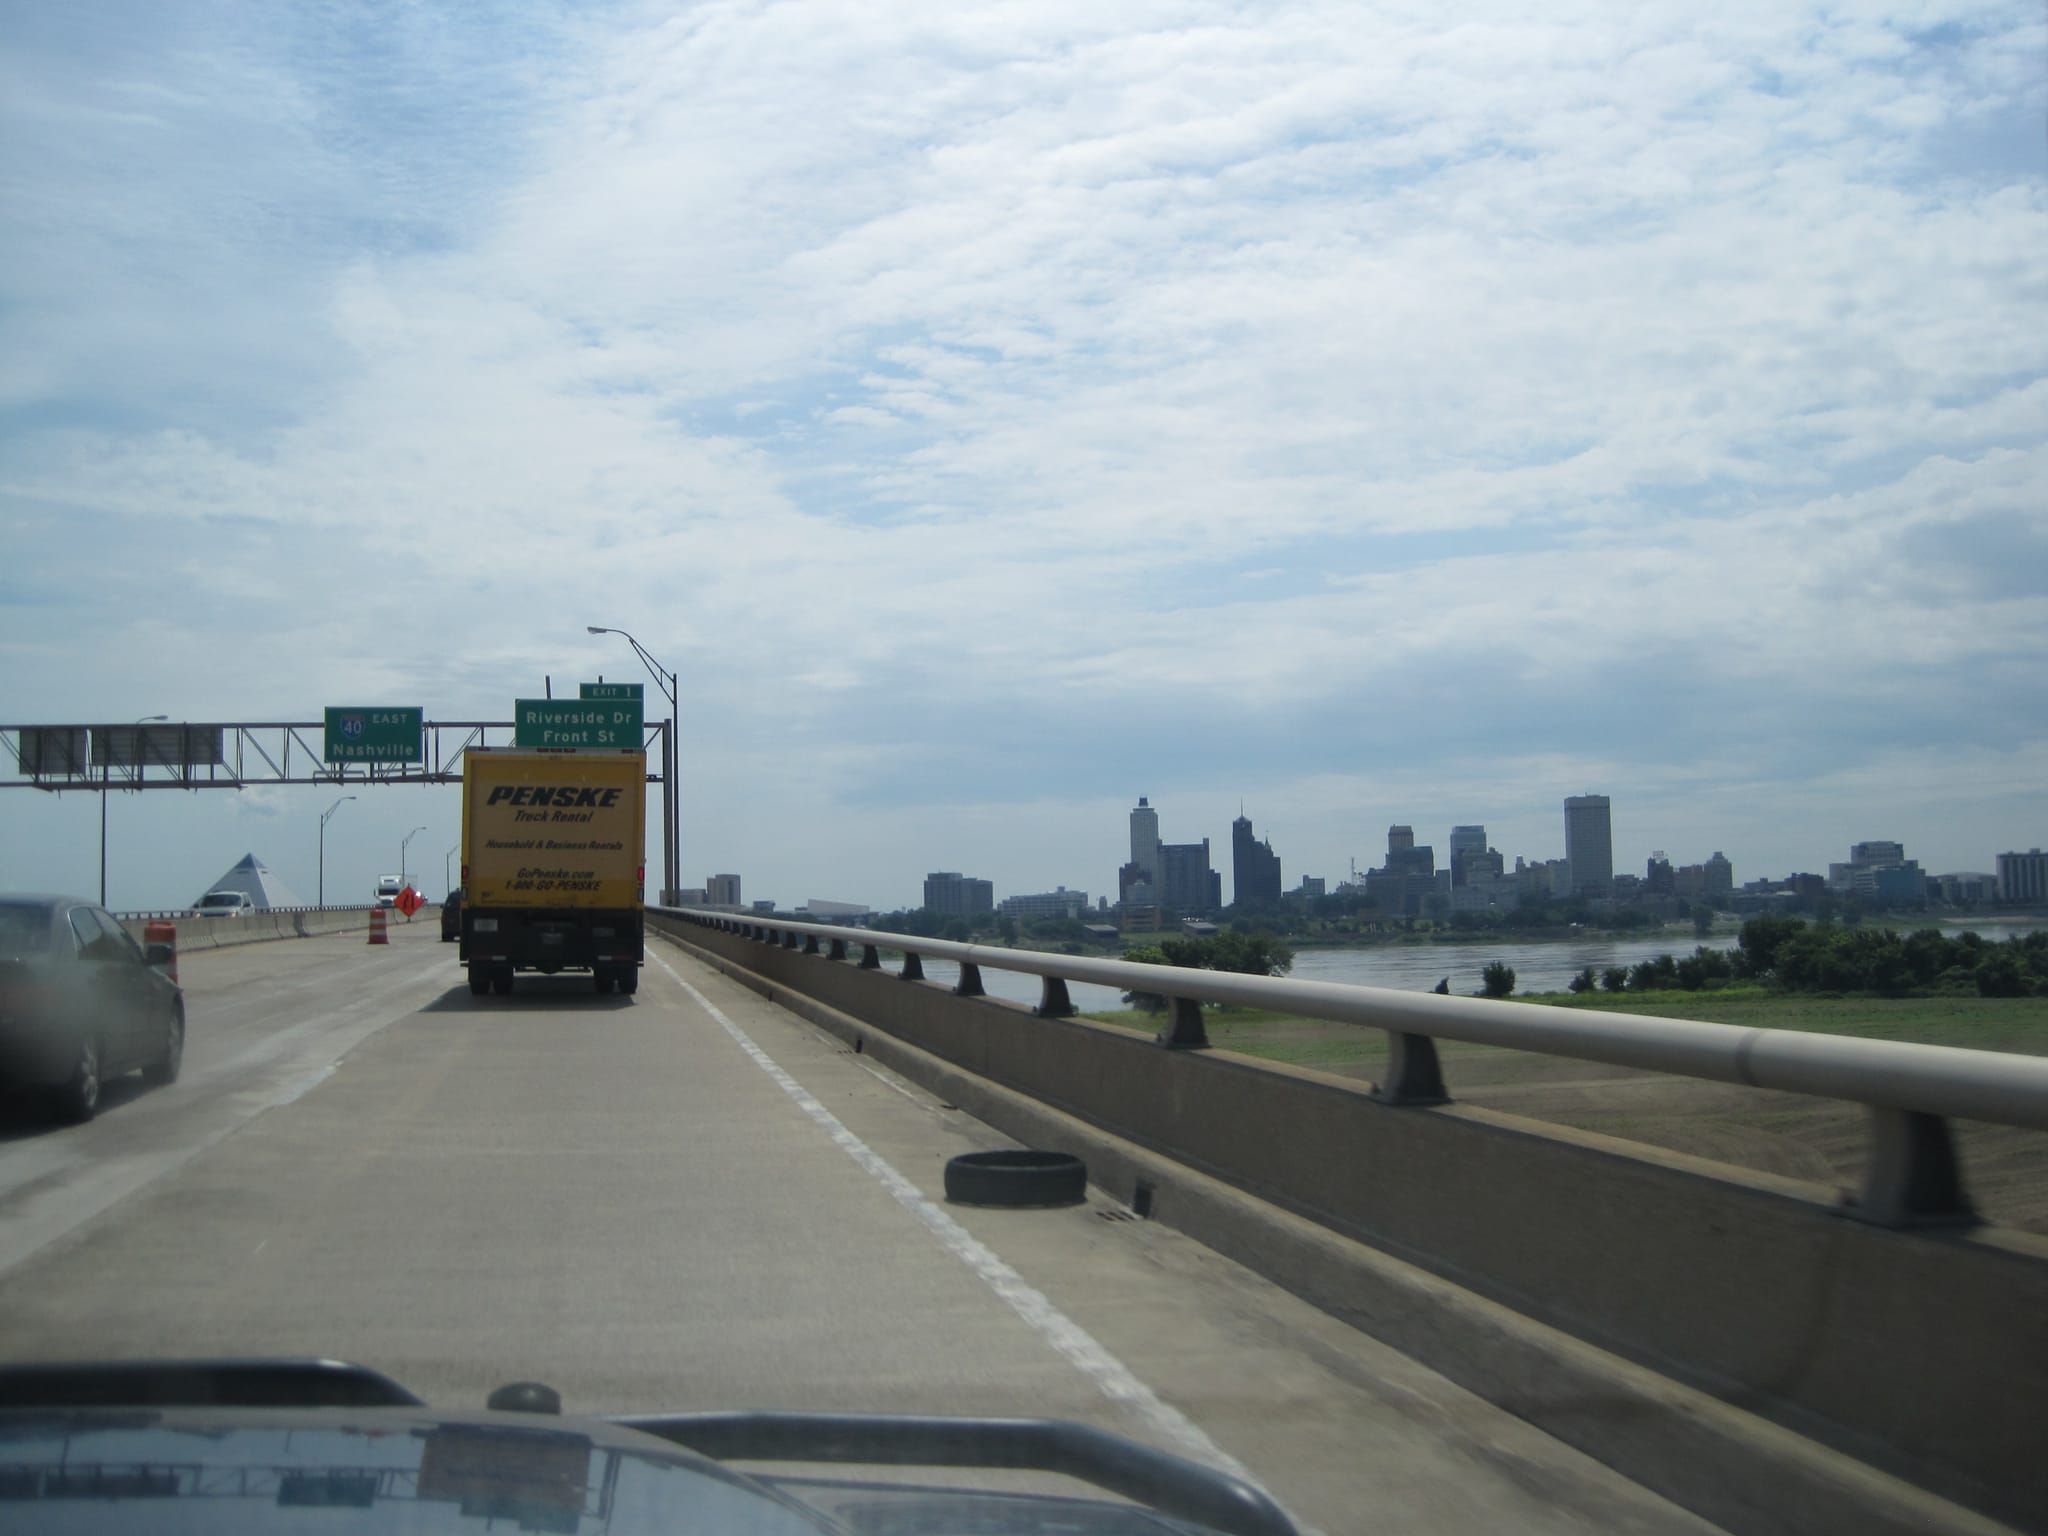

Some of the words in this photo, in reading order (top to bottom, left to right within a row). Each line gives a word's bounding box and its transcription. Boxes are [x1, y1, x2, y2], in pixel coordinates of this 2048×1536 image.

[592, 687, 617, 696] EXIT
[626, 687, 631, 697] 1
[343, 720, 362, 734] 40
[372, 713, 408, 724] EAST
[526, 711, 605, 724] Riverside
[613, 711, 633, 724] Dr
[543, 730, 588, 743] Front
[597, 730, 616, 743] St
[333, 743, 414, 756] Nashville
[487, 786, 623, 807] PENSKE
[515, 810, 548, 822] Truck
[551, 811, 593, 822] Rental
[485, 839, 535, 849] Household
[536, 840, 544, 849] &
[545, 840, 587, 850] Business
[588, 840, 624, 850] Rentals
[517, 867, 594, 879] GoPenske.com
